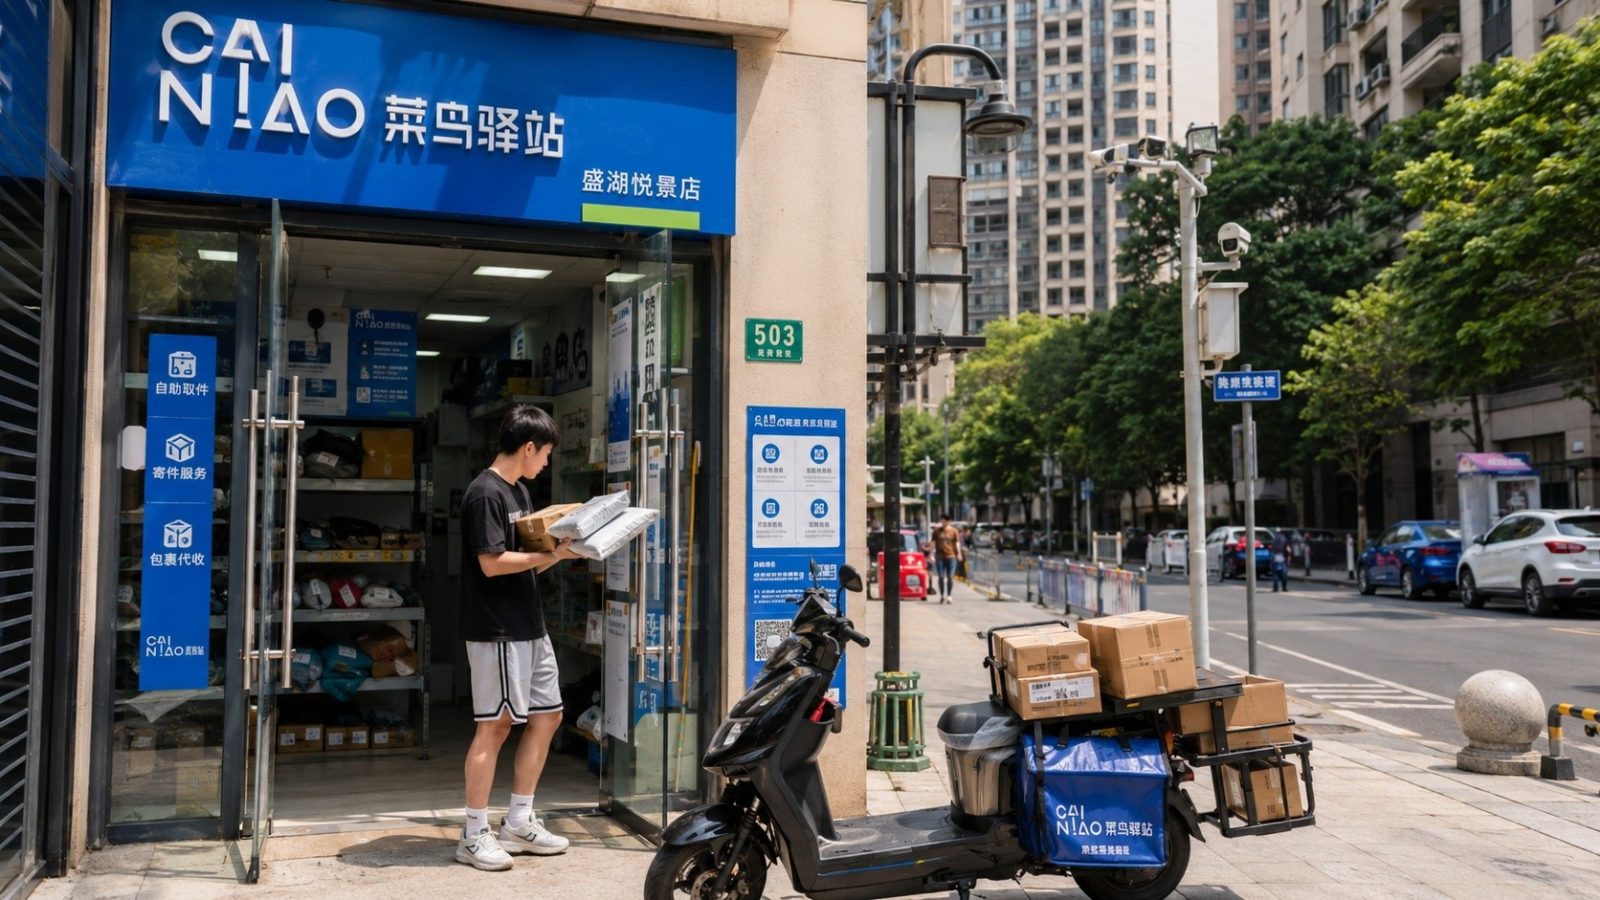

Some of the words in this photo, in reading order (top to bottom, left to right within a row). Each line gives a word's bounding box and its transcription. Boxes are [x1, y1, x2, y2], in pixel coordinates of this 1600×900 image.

[161, 10, 293, 76] CAI
[159, 62, 365, 138] NIAO
[385, 94, 565, 159] 菜鸟驿站
[582, 168, 701, 201] 盛湖悦景店
[754, 323, 795, 347] 503
[155, 381, 209, 396] 自助取件
[152, 466, 207, 480] 寄件服务
[150, 553, 205, 567] 包裹代收
[146, 635, 171, 646] CAI
[1056, 804, 1085, 820] CAI
